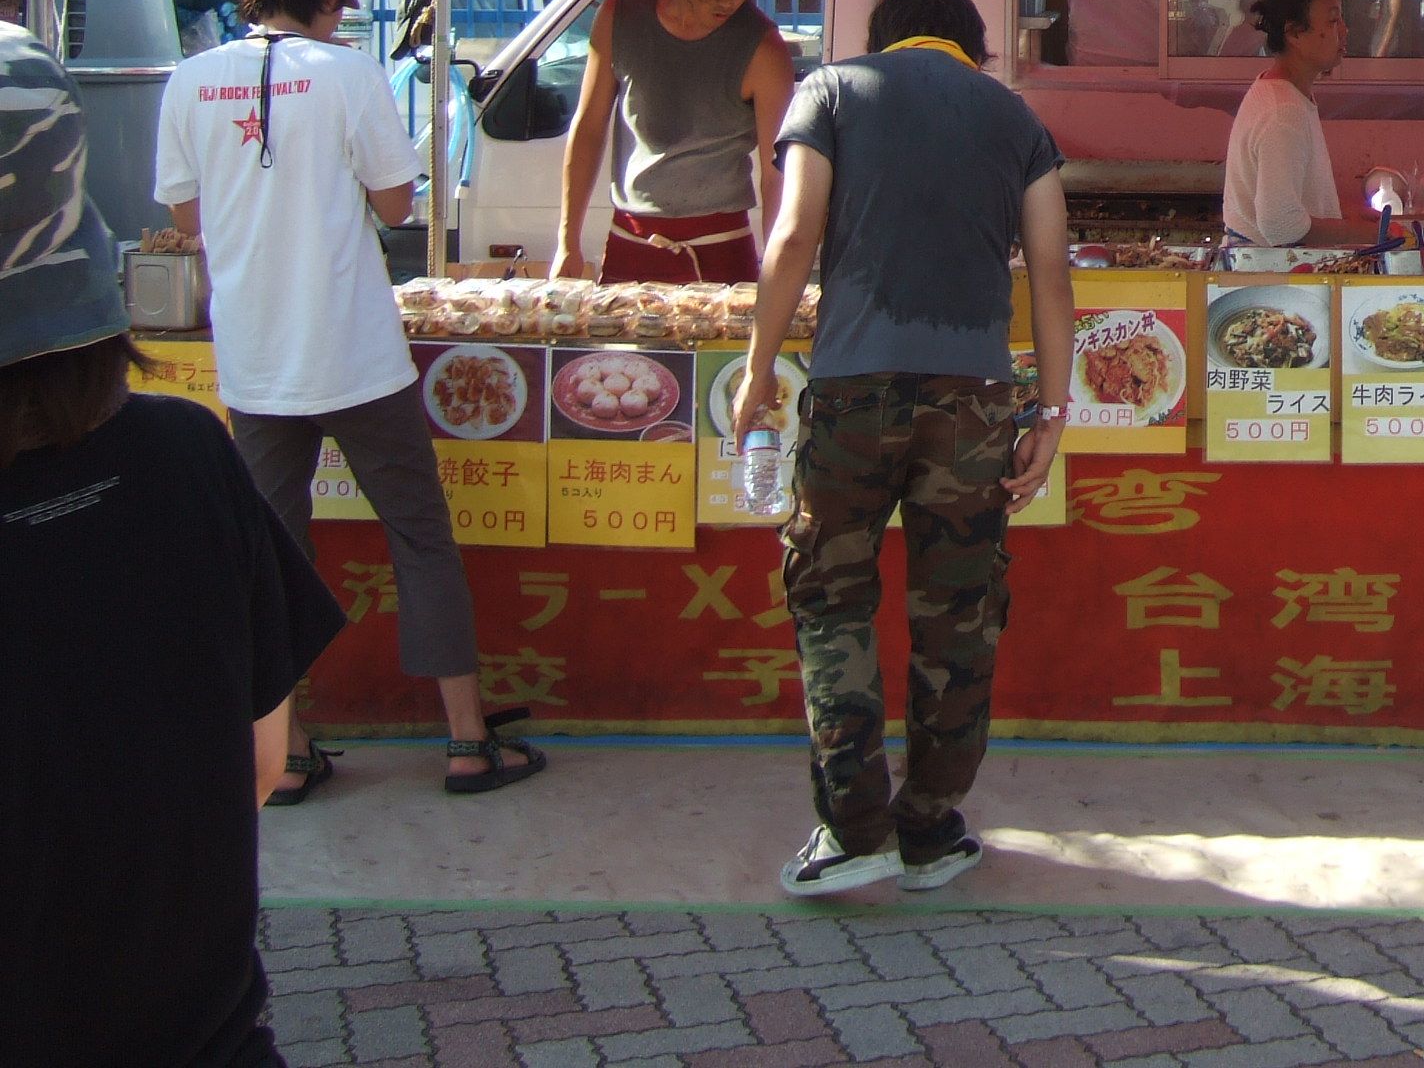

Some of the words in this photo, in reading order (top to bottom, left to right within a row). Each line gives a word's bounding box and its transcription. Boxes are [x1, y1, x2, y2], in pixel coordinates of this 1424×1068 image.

[220, 86, 249, 100] ROCK
[1075, 313, 1156, 355] ンギスカン丼
[1207, 370, 1272, 391] 肉野菜
[1267, 393, 1330, 414] ライス
[1227, 421, 1310, 440] 500円
[559, 459, 682, 484] 上海肉まん
[457, 510, 525, 532] 00円
[583, 510, 676, 533] 500円
